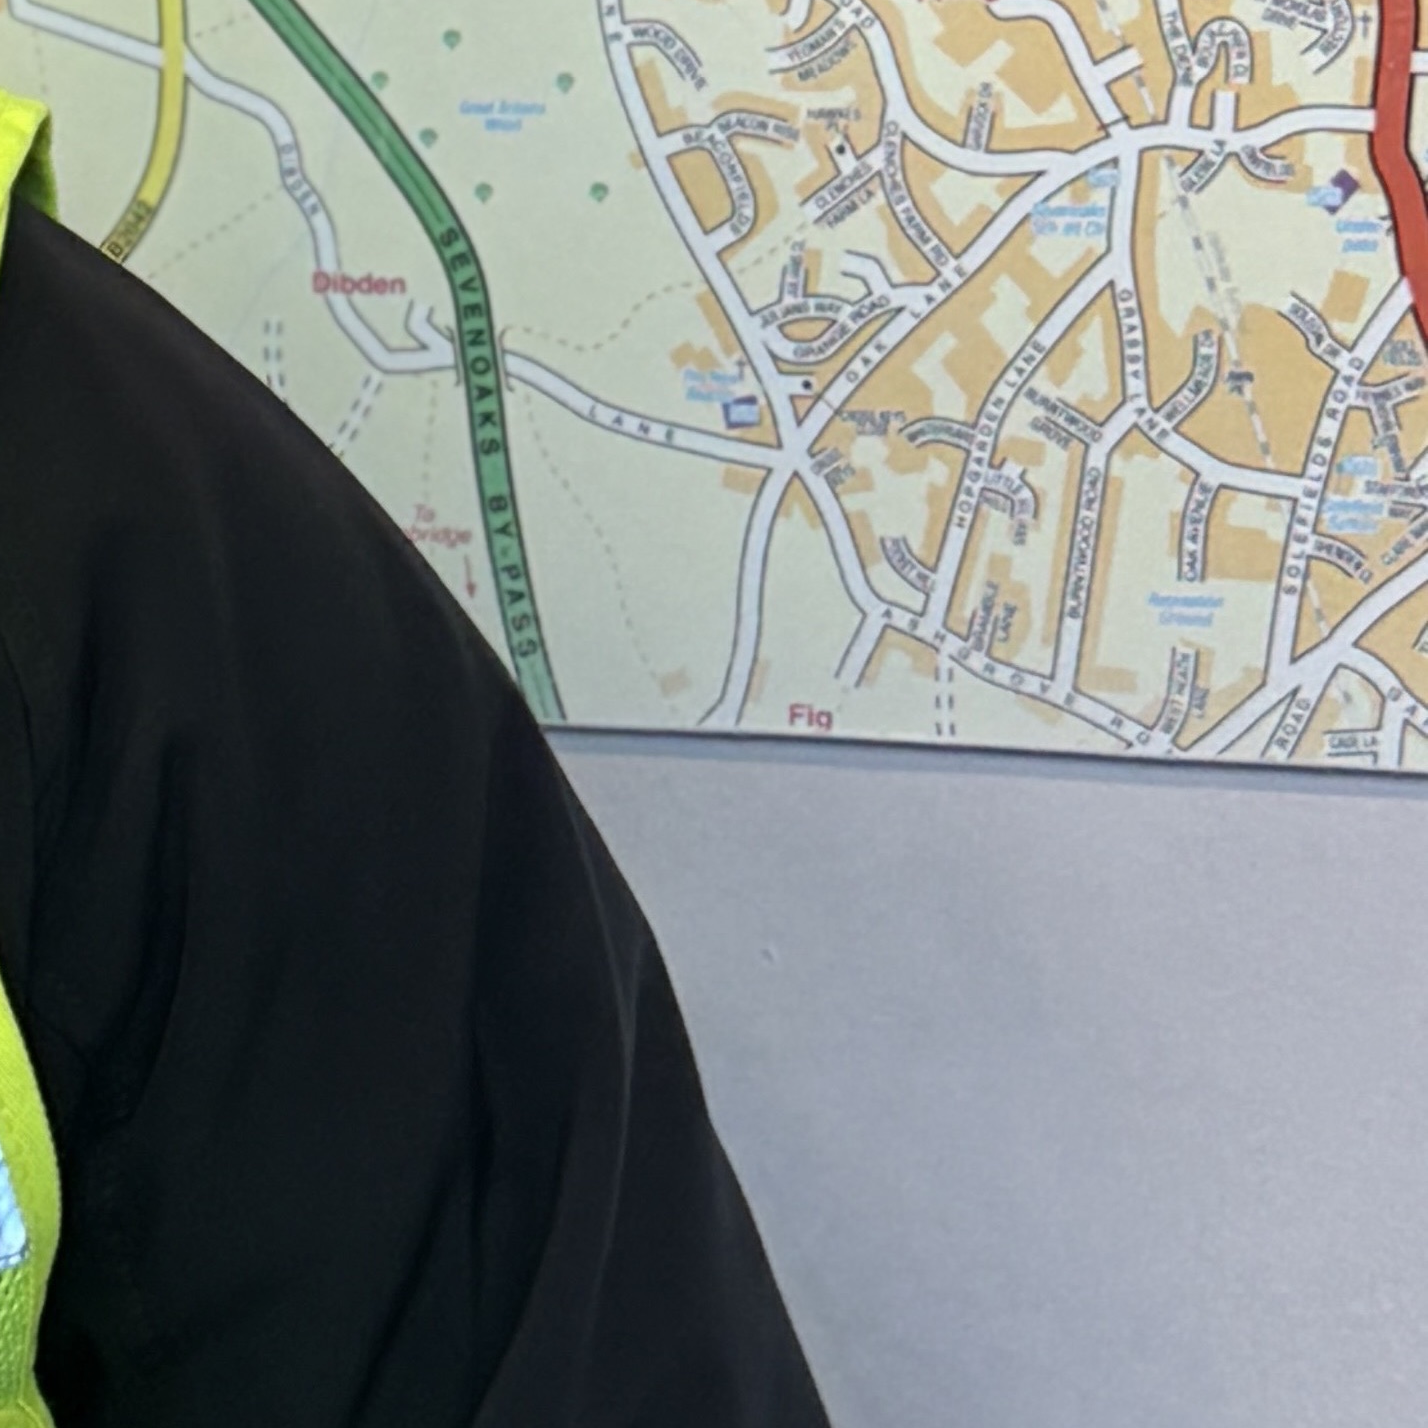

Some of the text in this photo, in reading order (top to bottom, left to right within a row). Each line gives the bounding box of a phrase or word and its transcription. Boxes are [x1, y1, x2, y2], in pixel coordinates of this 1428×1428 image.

[311, 273, 407, 297] Dibden
[849, 294, 891, 323] ROAD
[438, 226, 502, 457] SEVENOAKS
[845, 263, 969, 384] OAK LANE
[588, 404, 677, 445] LANE
[956, 339, 1046, 529] HOPGARDEN LANE
[1081, 467, 1101, 513] ROAD
[1283, 356, 1365, 596] SOLEFIELDS ROAD
[788, 705, 833, 731] Fig
[1274, 696, 1312, 752] ROAD
